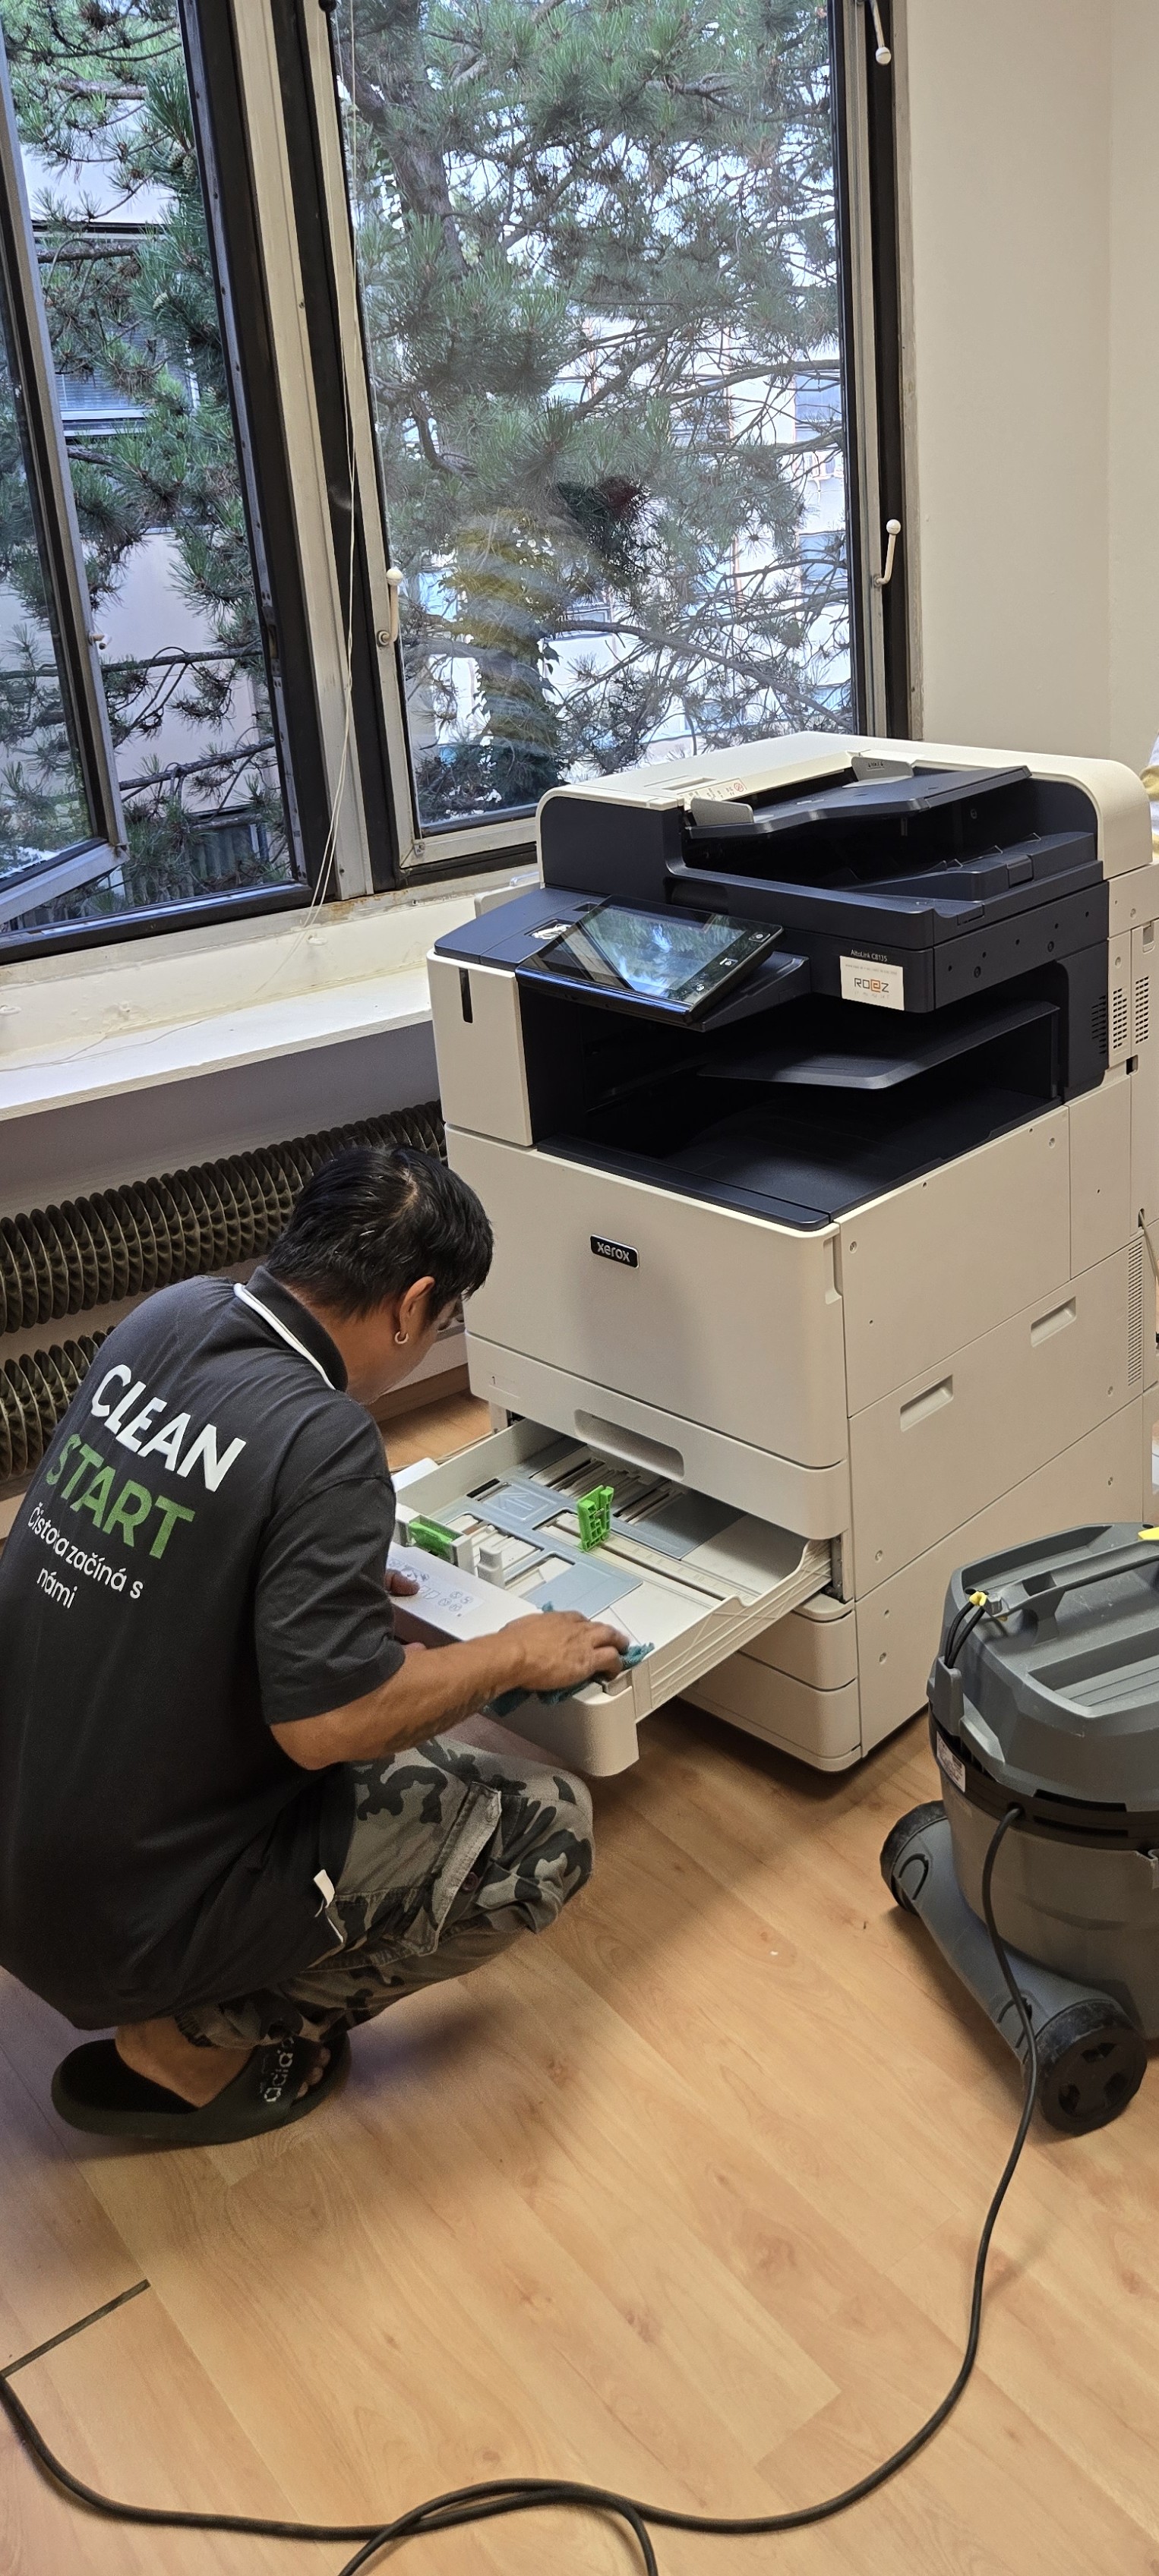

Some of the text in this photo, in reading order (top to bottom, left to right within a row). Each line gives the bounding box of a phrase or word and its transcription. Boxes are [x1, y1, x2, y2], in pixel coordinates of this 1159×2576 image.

[871, 953, 888, 963] C8135
[597, 1241, 630, 1263] xerox
[90, 1364, 247, 1493] CLEAN
[46, 1433, 196, 1559] START
[36, 1568, 77, 1609] námi
[65, 1545, 128, 1592] začíná
[129, 1580, 144, 1599] s
